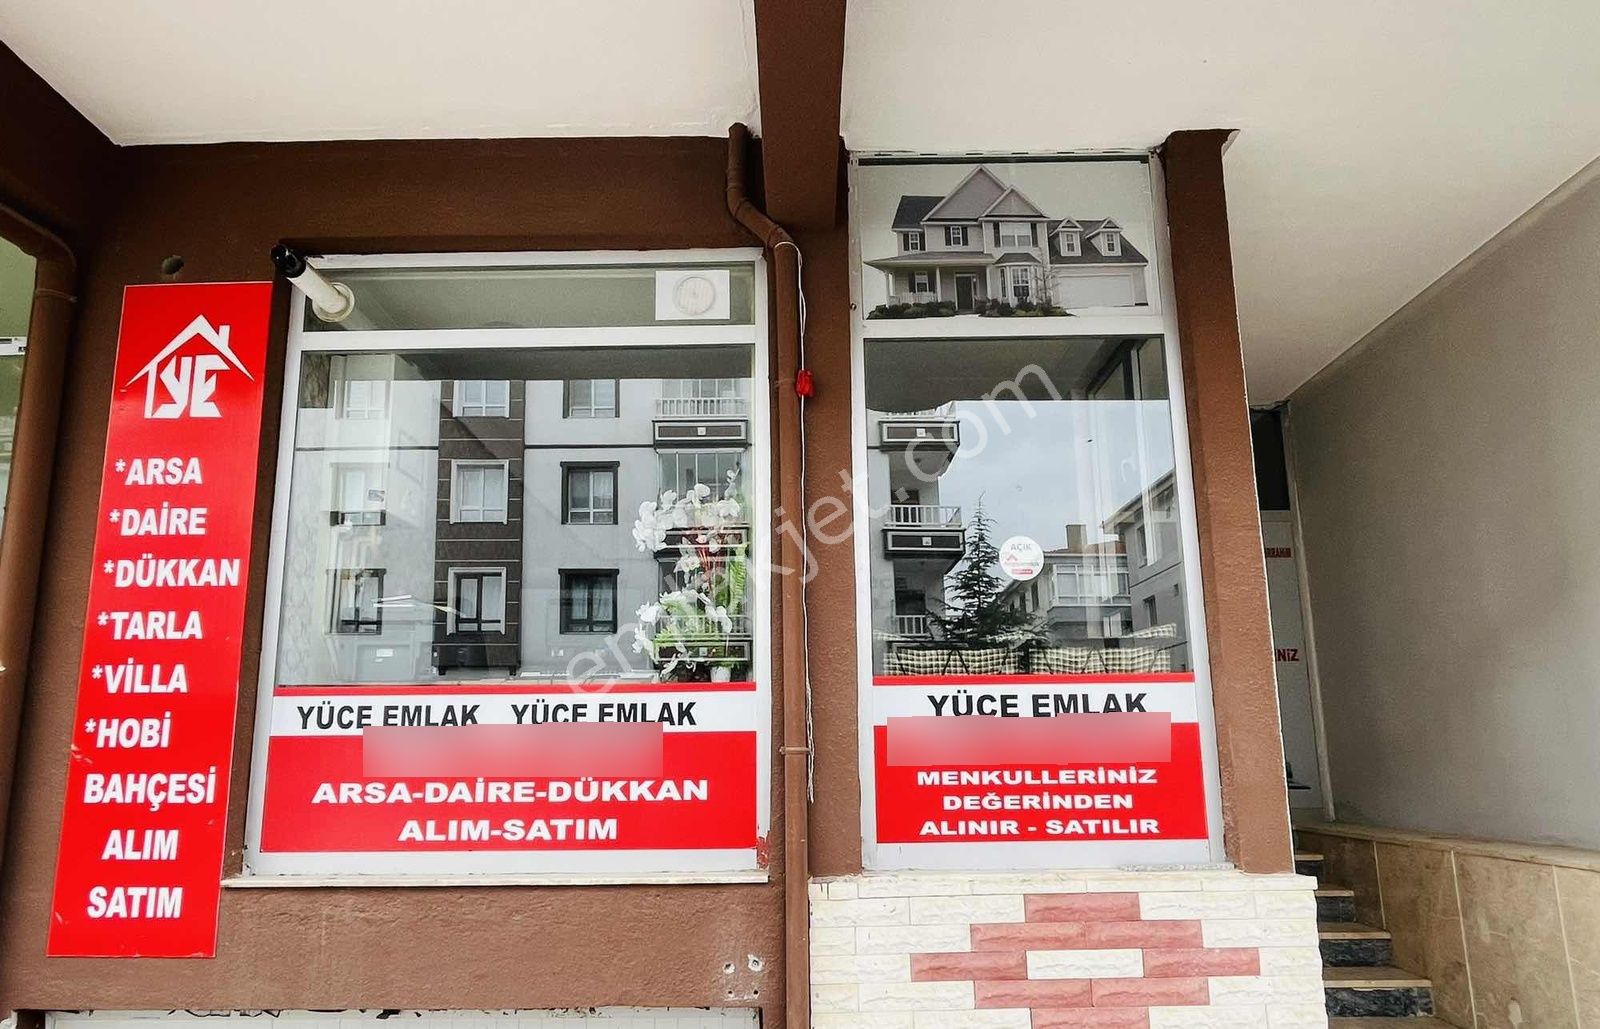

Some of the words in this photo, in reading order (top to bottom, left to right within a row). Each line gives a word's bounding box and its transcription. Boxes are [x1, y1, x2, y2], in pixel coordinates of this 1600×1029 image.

[298, 701, 372, 729] YÜCE
[383, 705, 479, 726] EMLAK
[511, 699, 587, 724] YÜCE
[599, 702, 696, 725] EMLAK
[928, 690, 1018, 717] YÜCE
[1032, 694, 1146, 717] EMLAK
[84, 767, 216, 811] BAHÇESİ
[918, 766, 1157, 785] MENKULLERİNİZ
[312, 776, 707, 803] ARSA-DAİRE-DÜKKAN
[944, 792, 1132, 810] DEĞERİNDEN
[398, 819, 617, 841] ALIM-SATIM
[920, 821, 1019, 835] ALINIR
[1046, 819, 1159, 834] SATILIR
[102, 830, 178, 860] ALIM
[88, 887, 182, 918] SATIM
